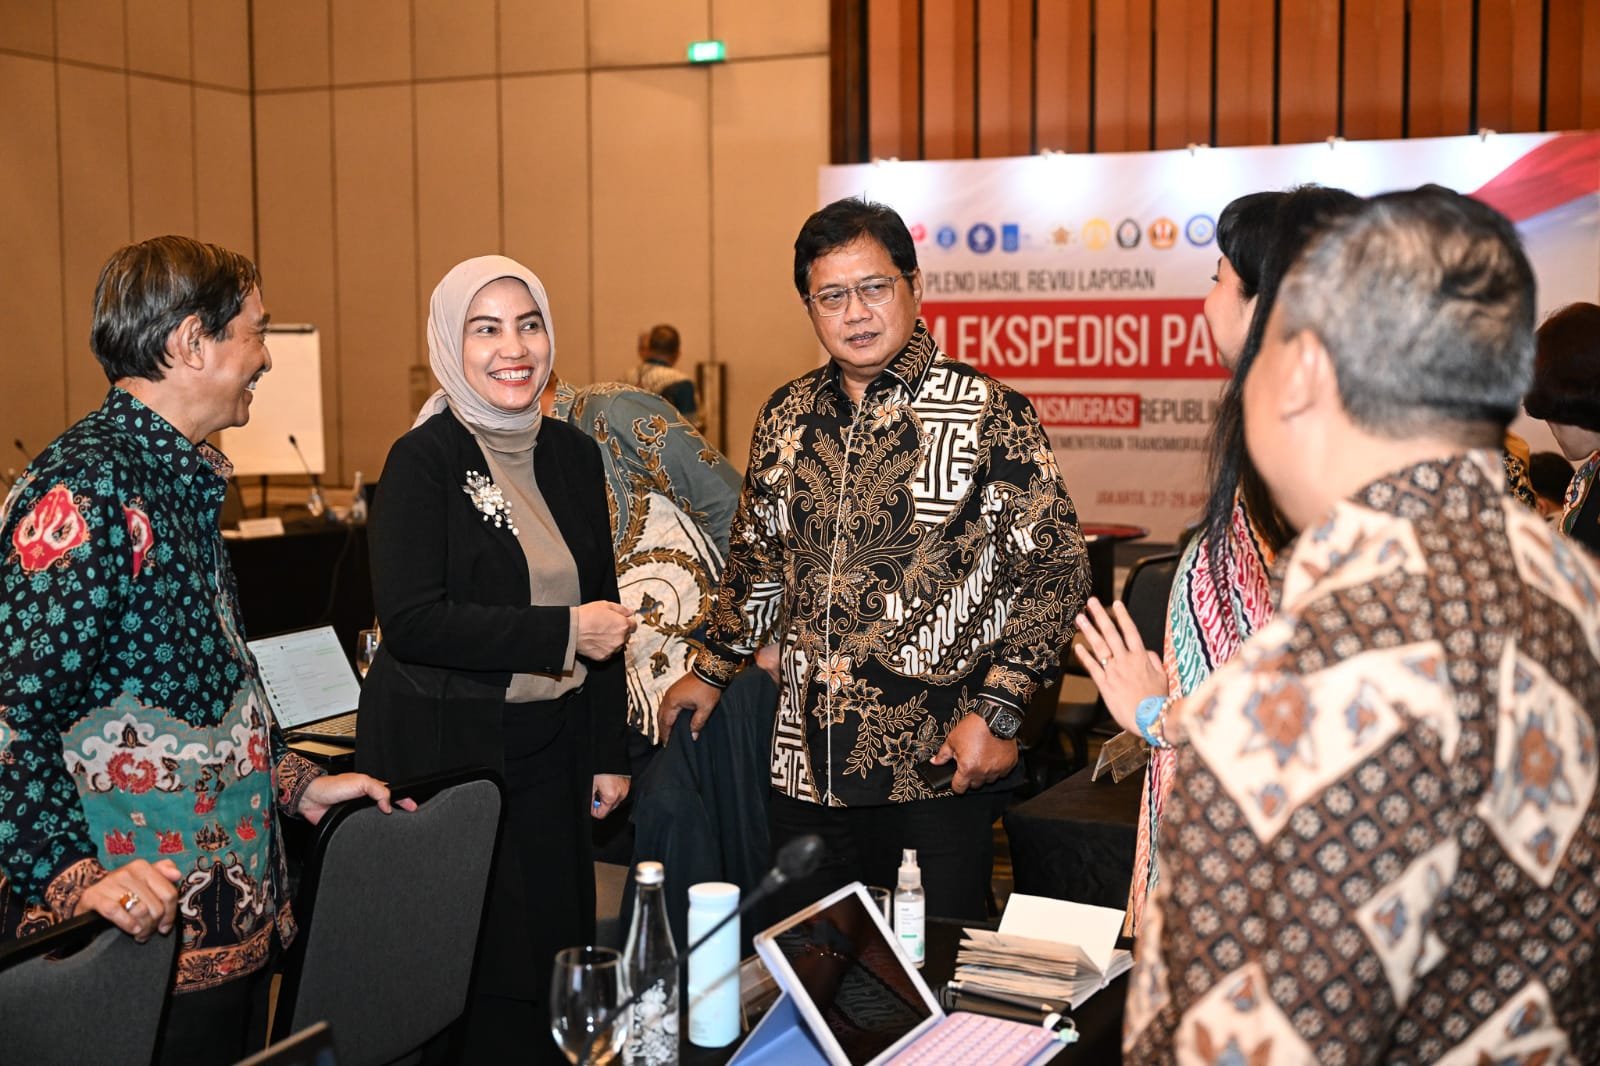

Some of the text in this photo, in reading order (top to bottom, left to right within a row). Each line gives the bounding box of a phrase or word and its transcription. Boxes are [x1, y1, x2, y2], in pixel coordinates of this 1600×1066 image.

[926, 267, 1155, 293] PLENO HASIL REVIU LAPORAN
[957, 314, 1149, 367] EKSPEDISI
[1161, 313, 1215, 366] PA
[1034, 396, 1216, 425] NSMIGRASI REPUBLI
